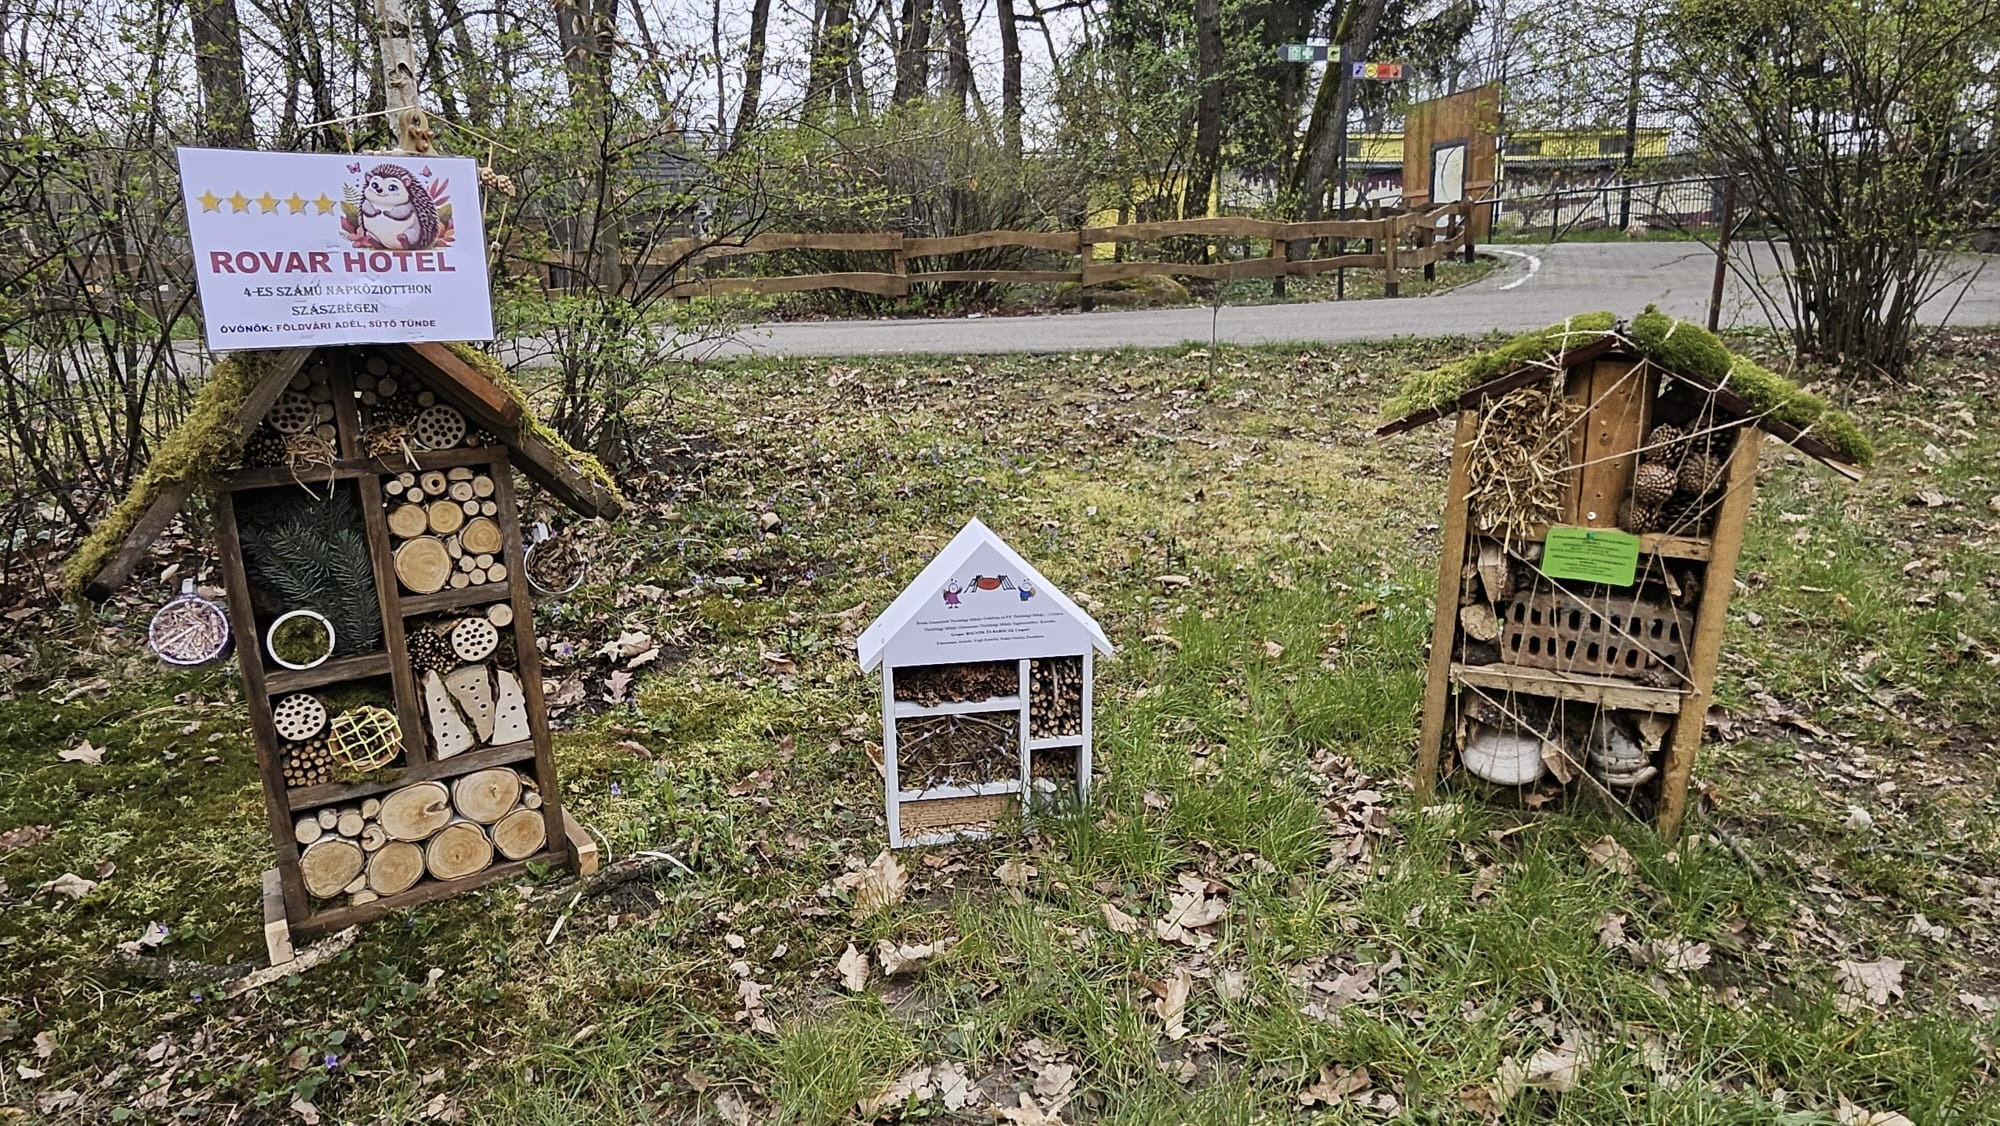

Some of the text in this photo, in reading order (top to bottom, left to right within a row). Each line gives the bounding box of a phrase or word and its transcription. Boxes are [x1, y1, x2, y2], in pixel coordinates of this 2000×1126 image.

[210, 251, 456, 274] ROVAR HOTEL
[243, 281, 432, 297] 4-ES SZÁMÚ NAPKÖZIOTTHON
[291, 302, 379, 316] SZÁSZRÉGEN
[276, 321, 331, 332] FÖLDVÁRI
[335, 319, 366, 329] ADÉL,
[400, 319, 437, 328] TÜNDE
